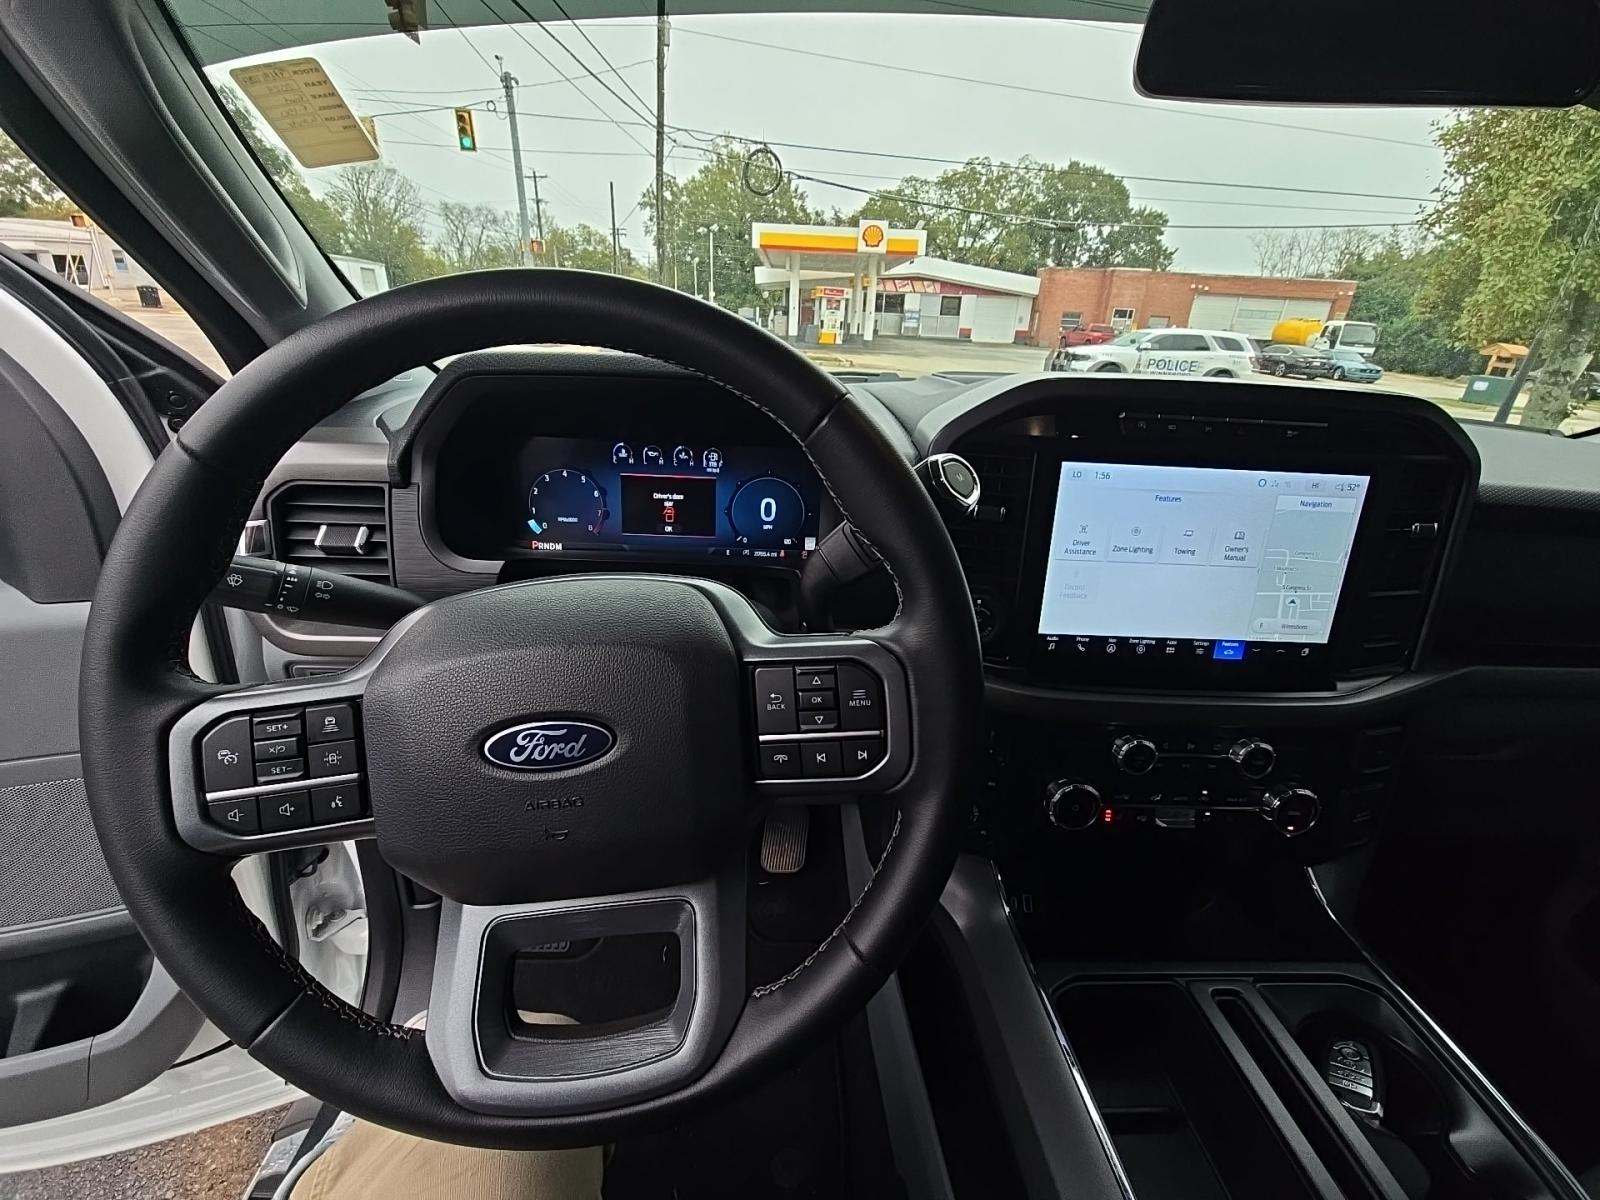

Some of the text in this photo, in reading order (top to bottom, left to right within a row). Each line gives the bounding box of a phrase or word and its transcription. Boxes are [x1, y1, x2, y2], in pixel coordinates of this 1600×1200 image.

[1147, 358, 1199, 372] POLICE
[544, 474, 549, 482] 3
[581, 475, 586, 483] 5
[1095, 472, 1111, 480] 1:56
[533, 487, 538, 495] 2
[594, 490, 599, 498] 6
[1155, 495, 1182, 503] Features
[1300, 500, 1332, 508] Navigation
[760, 497, 776, 521] 0
[1072, 539, 1091, 547] Driver
[1064, 547, 1097, 556] Assistance
[1112, 545, 1154, 555] Zone Lighting
[1174, 548, 1196, 557] Towing
[1224, 545, 1249, 554] Owner's
[811, 696, 823, 704] OK
[766, 703, 786, 711] BACK
[266, 723, 289, 733] SET+
[509, 729, 588, 762] Ford
[525, 796, 585, 812] AIRBAG
